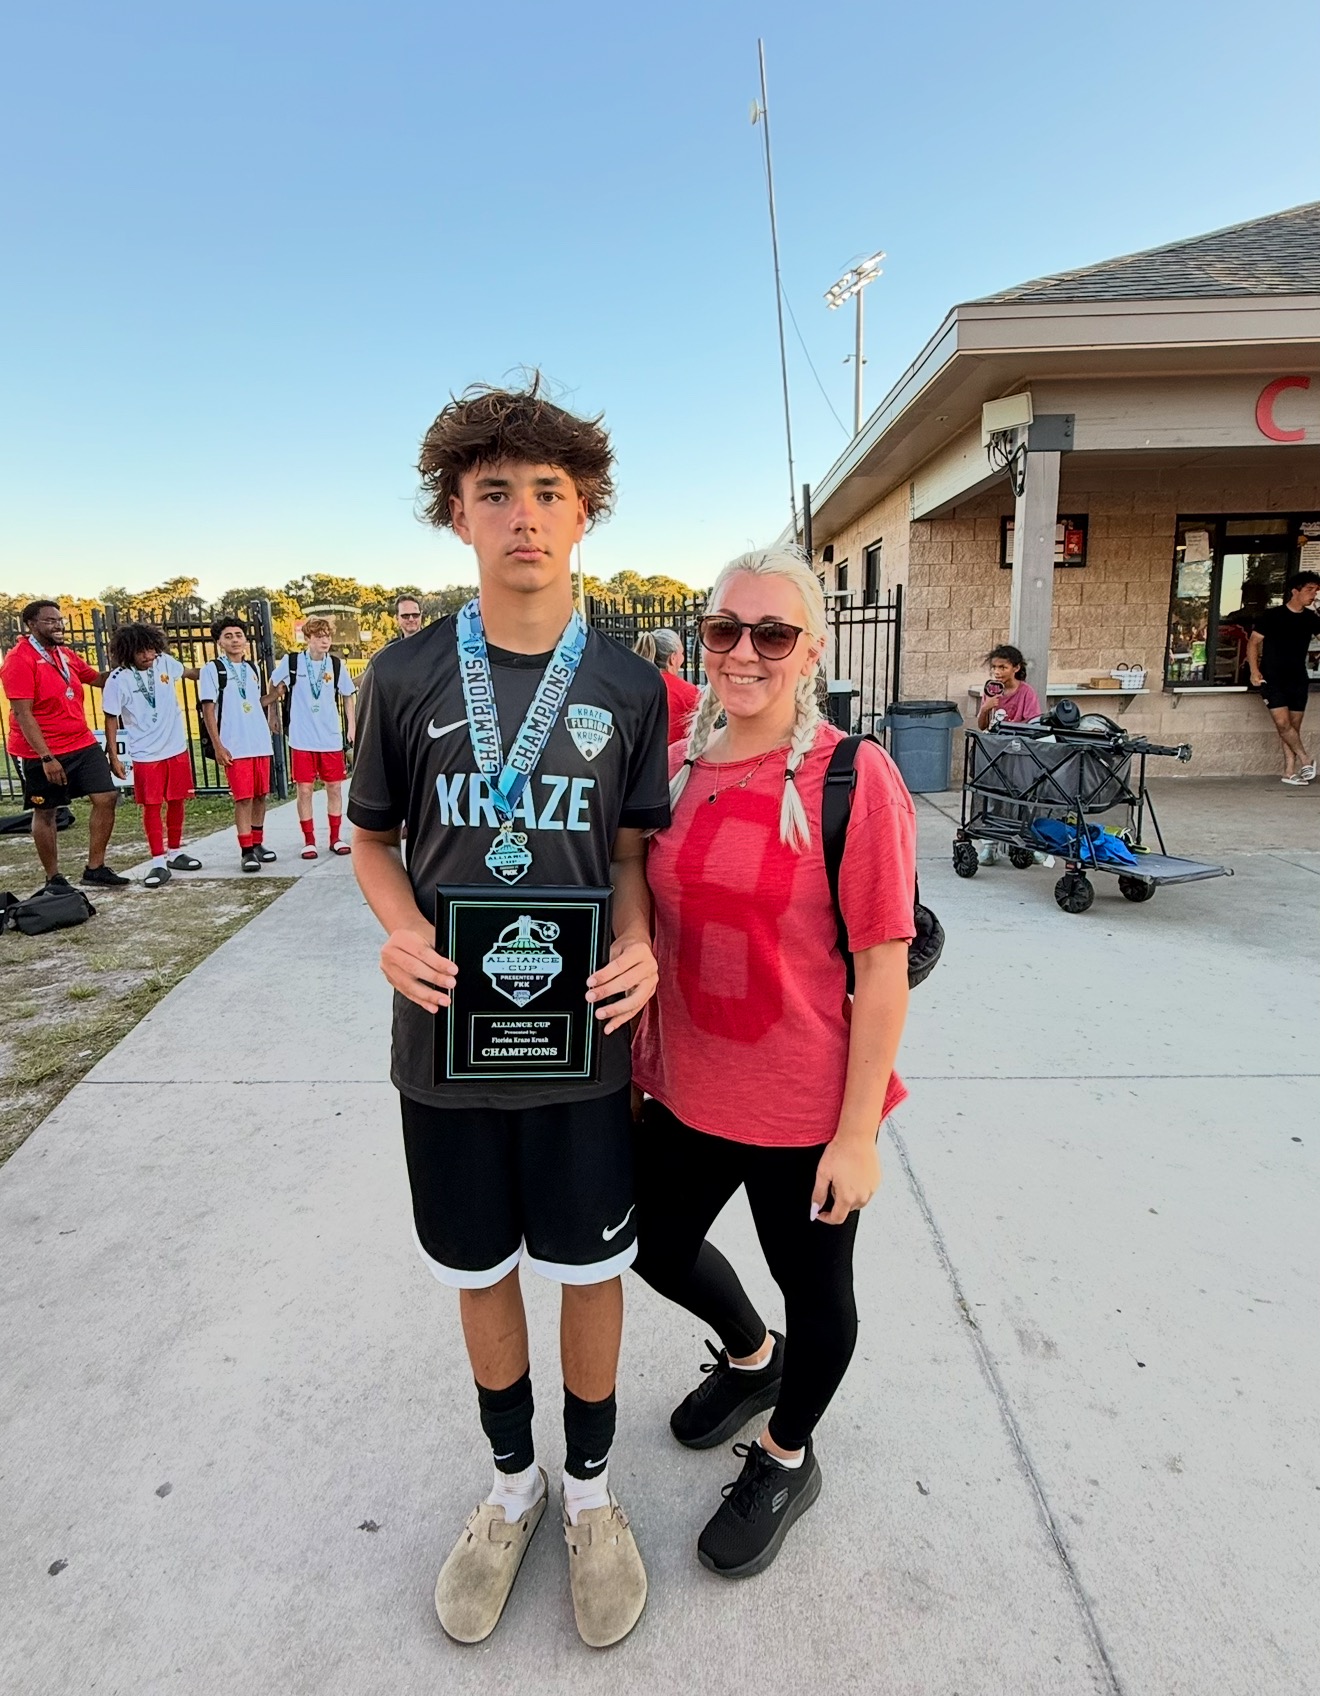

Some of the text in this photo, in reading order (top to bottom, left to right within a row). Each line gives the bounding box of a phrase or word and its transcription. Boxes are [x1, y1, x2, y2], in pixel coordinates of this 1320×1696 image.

[1255, 375, 1311, 442] C
[465, 659, 498, 774] CHAMPIONS
[511, 663, 572, 774] CHAMPIONS
[577, 708, 603, 720] KRAZE
[571, 718, 608, 734] FLORIDA
[577, 731, 604, 742] KRUSH
[486, 956, 560, 964] ALLIANCE
[481, 1047, 558, 1057] CHAMPIONS
